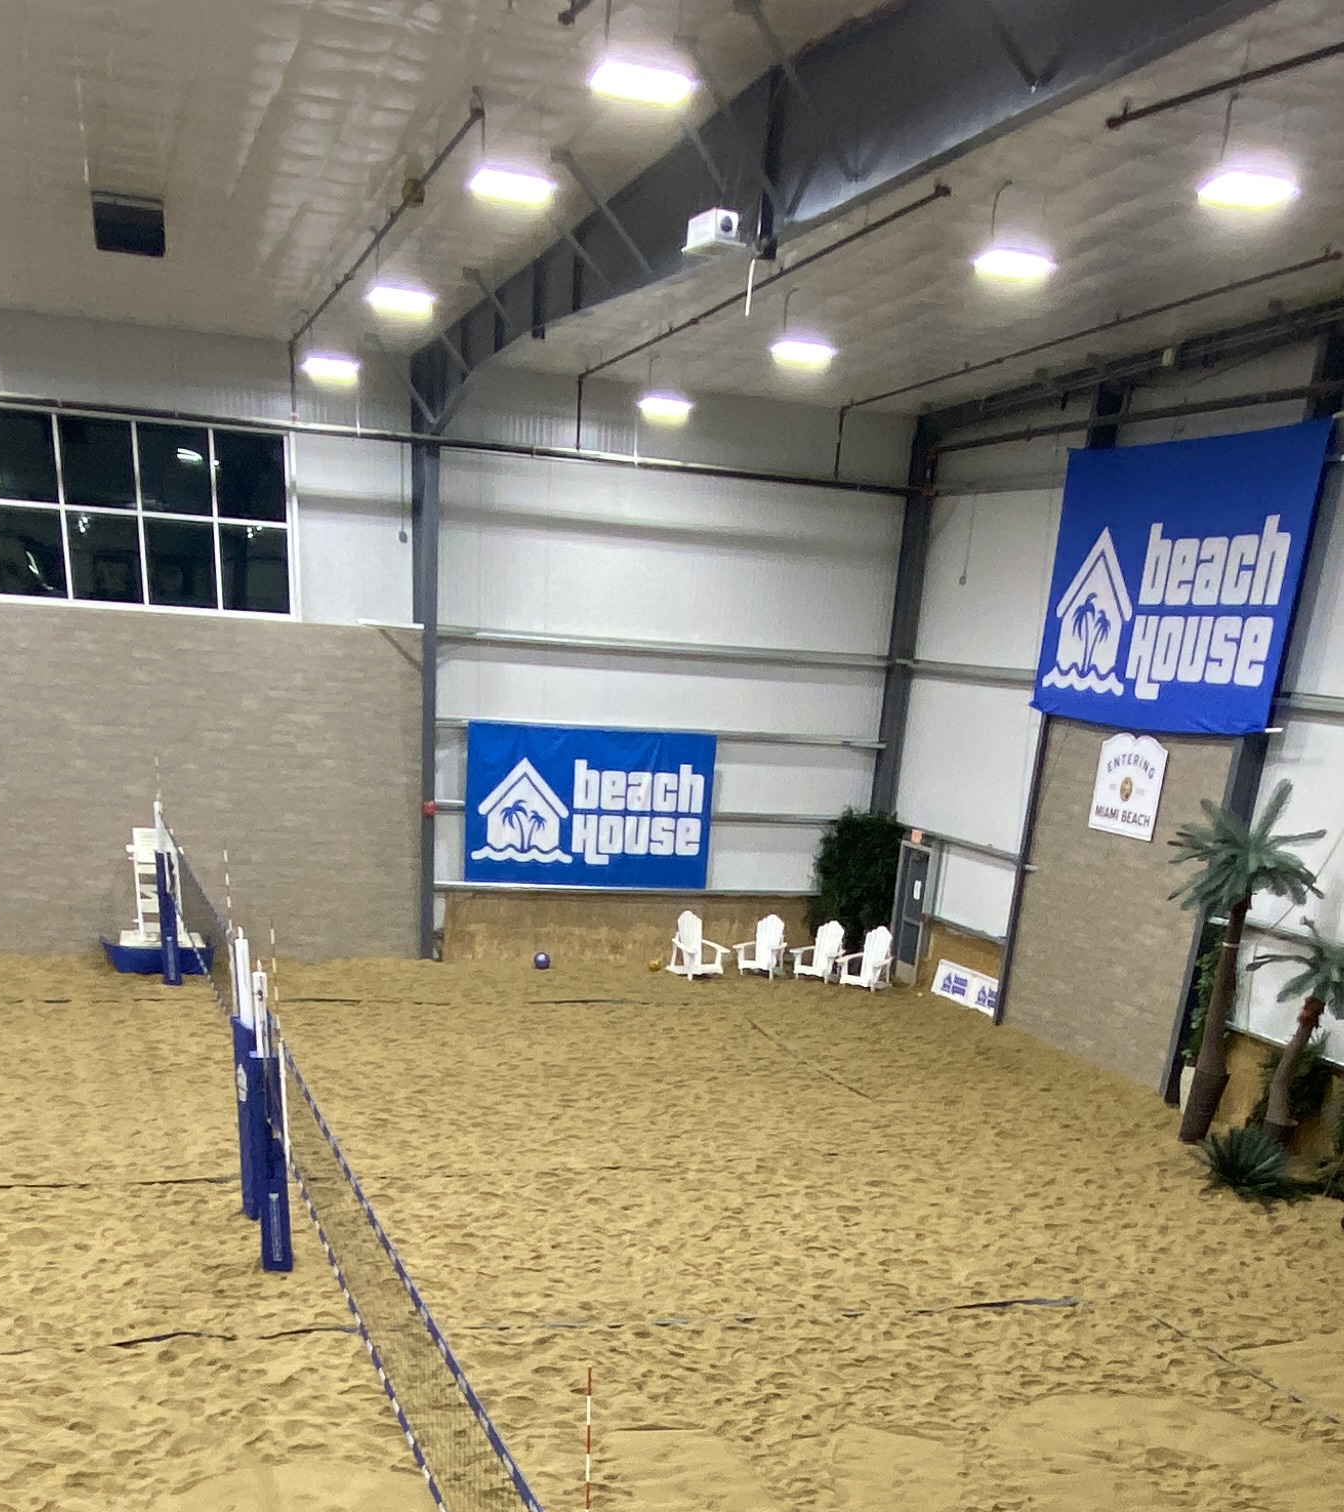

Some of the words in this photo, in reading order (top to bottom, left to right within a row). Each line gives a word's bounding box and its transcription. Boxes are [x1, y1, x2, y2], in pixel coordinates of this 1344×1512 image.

[1138, 513, 1292, 606] beach
[572, 758, 705, 813] beach
[1107, 752, 1155, 779] ENTERING
[1095, 805, 1119, 820] MIAMI
[1121, 810, 1151, 827] BEACH
